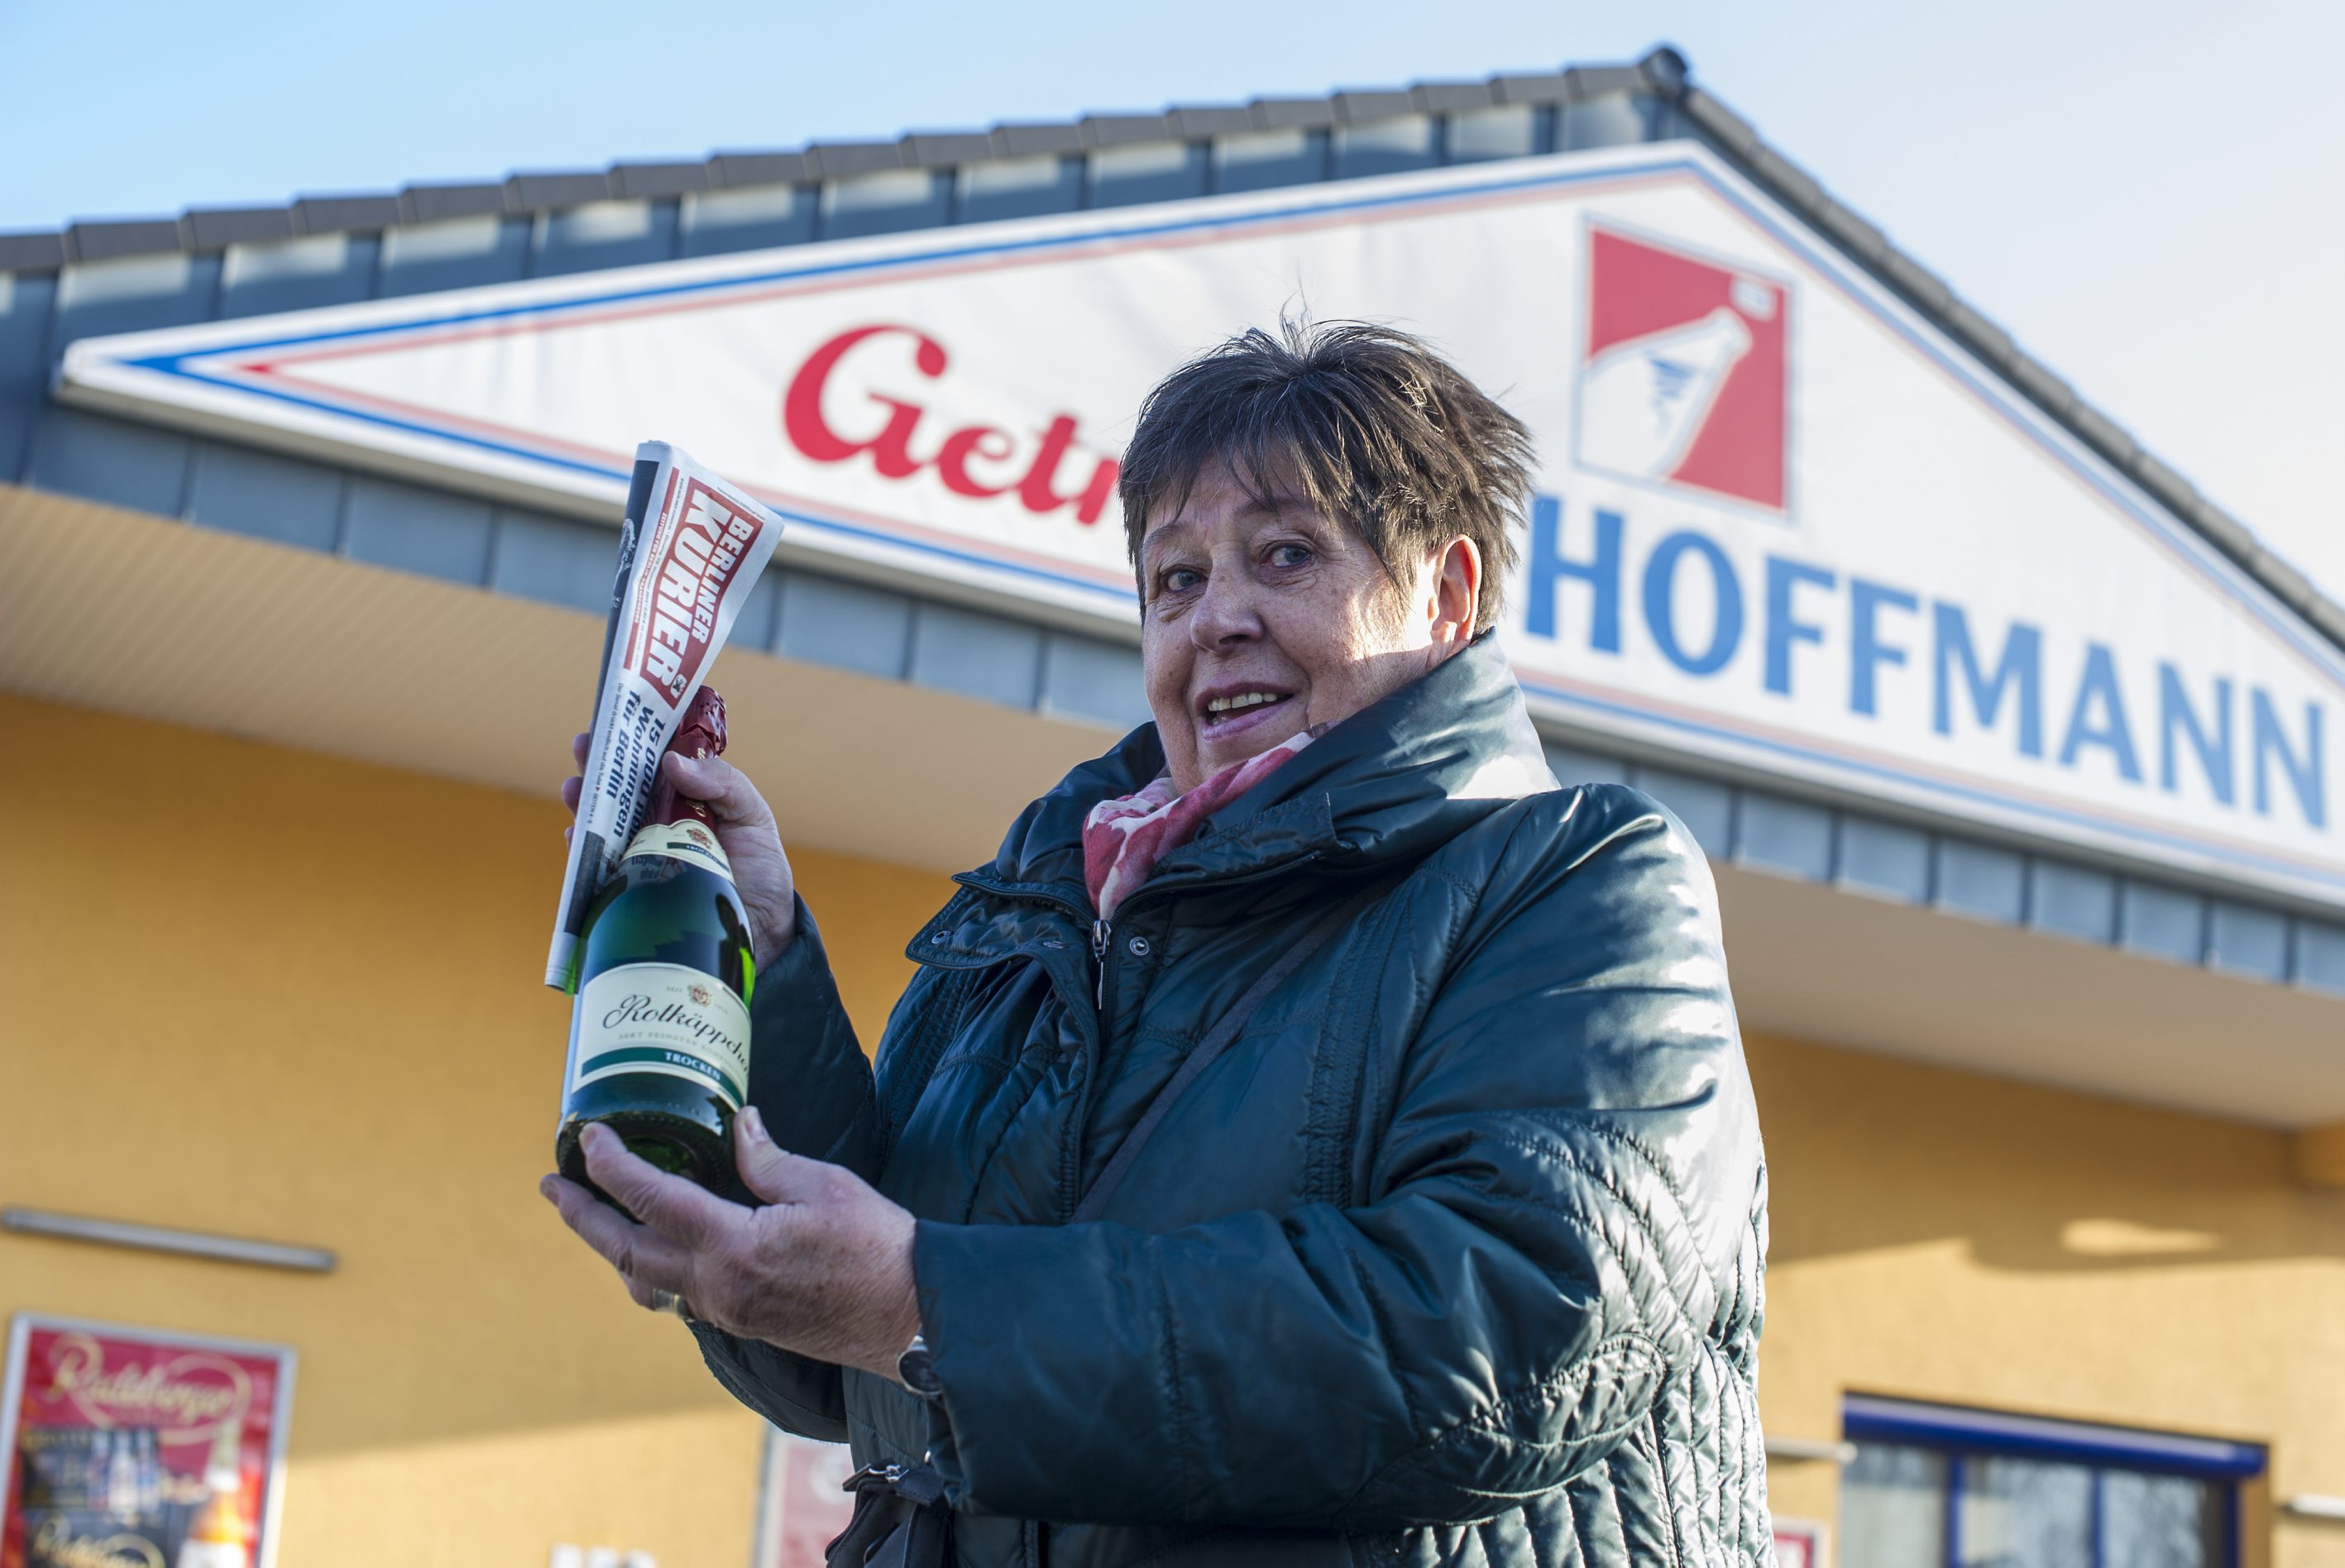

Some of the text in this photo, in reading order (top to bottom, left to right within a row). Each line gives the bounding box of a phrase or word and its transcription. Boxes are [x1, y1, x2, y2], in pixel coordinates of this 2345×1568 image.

[656, 512, 667, 539] ZEITUNG
[647, 489, 732, 685] KURIER
[692, 514, 754, 645] BERLINER
[1524, 493, 2327, 832] HOFFMANN
[623, 690, 641, 726] für
[649, 717, 665, 746] 15
[606, 729, 629, 799] Berlin
[614, 706, 654, 838] Wohnungen
[641, 747, 656, 796] 000
[664, 1051, 722, 1081] TROCKEN
